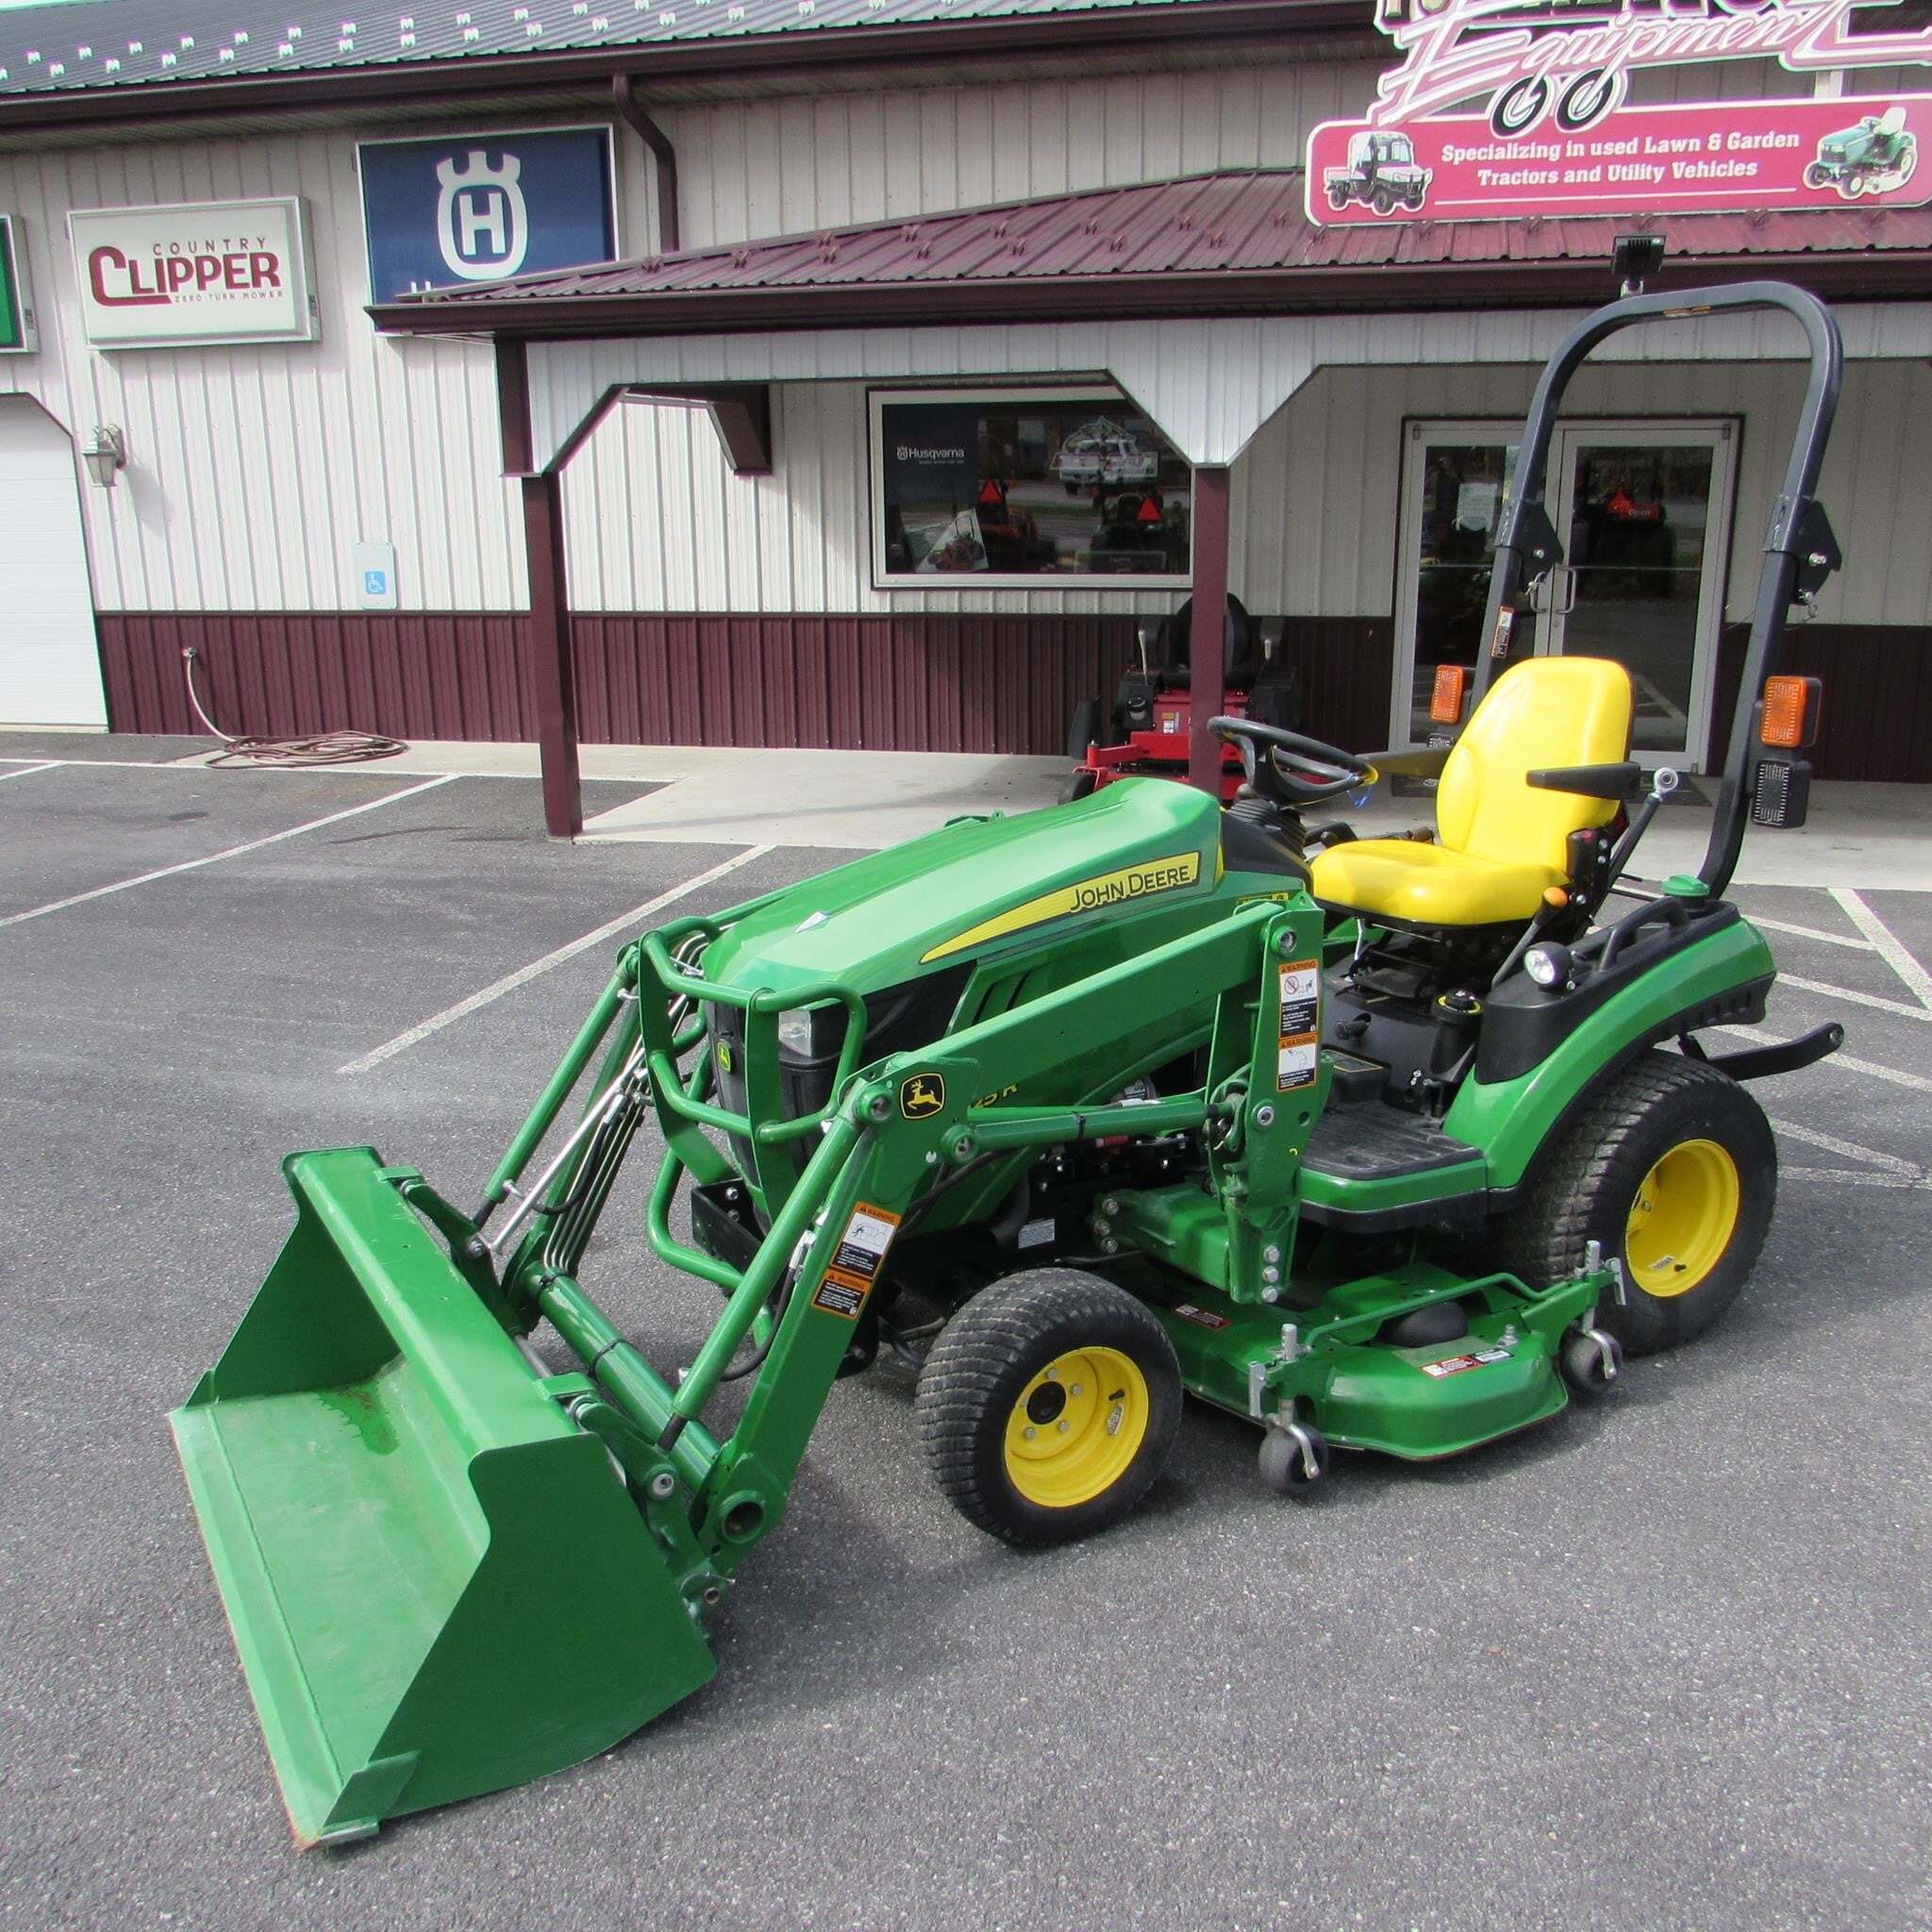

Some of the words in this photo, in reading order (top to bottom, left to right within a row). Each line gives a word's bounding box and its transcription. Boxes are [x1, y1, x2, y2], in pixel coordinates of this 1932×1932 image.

[1377, 0, 1863, 125] Equipment
[1441, 142, 1561, 165] Specializing
[1566, 140, 1585, 158] in
[1590, 137, 1639, 157] used
[1643, 136, 1701, 155] Lawn
[1707, 132, 1722, 152] &
[1726, 130, 1800, 150] Garden
[1477, 168, 1558, 187] Tractors
[1563, 164, 1601, 183] and
[1607, 162, 1665, 184] Utility
[1671, 159, 1758, 179] Vehicles
[153, 237, 266, 257] COUNTRY
[89, 245, 281, 307] CLIPPER
[175, 294, 202, 304] ZERO
[208, 292, 235, 302] TURN
[242, 291, 284, 300] MOWER
[908, 447, 964, 459] Husqvarna
[1070, 880, 1124, 911] JOHN
[1127, 865, 1191, 896] DEERE
